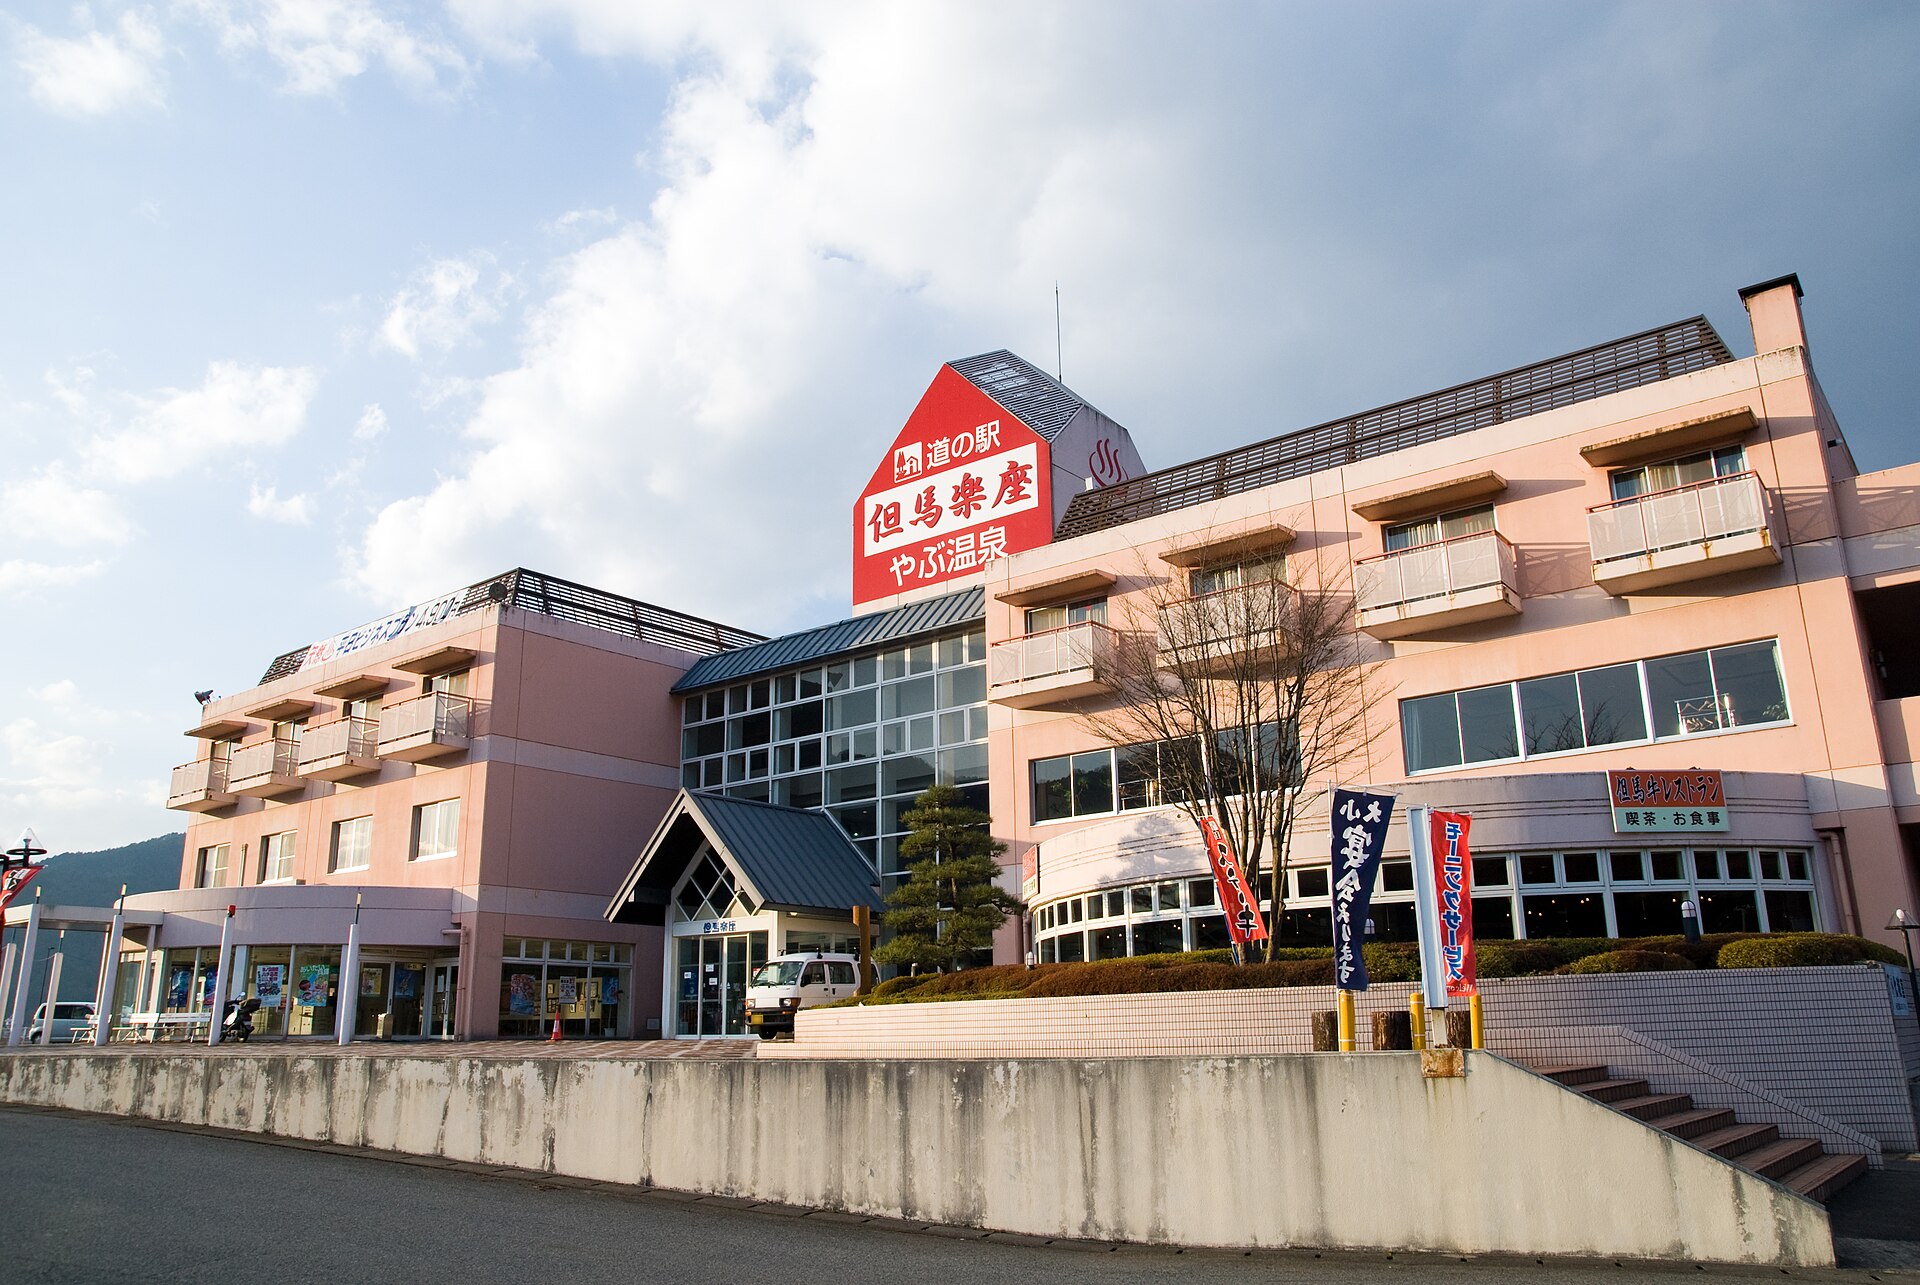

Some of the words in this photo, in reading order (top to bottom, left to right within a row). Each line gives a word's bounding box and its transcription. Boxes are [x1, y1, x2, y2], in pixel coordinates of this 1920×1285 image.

[926, 420, 1001, 470] 道の駅
[868, 460, 1034, 543] 但馬楽座
[889, 525, 1008, 587] やぶ温泉
[1616, 774, 1719, 804] 但馬牛レストラン
